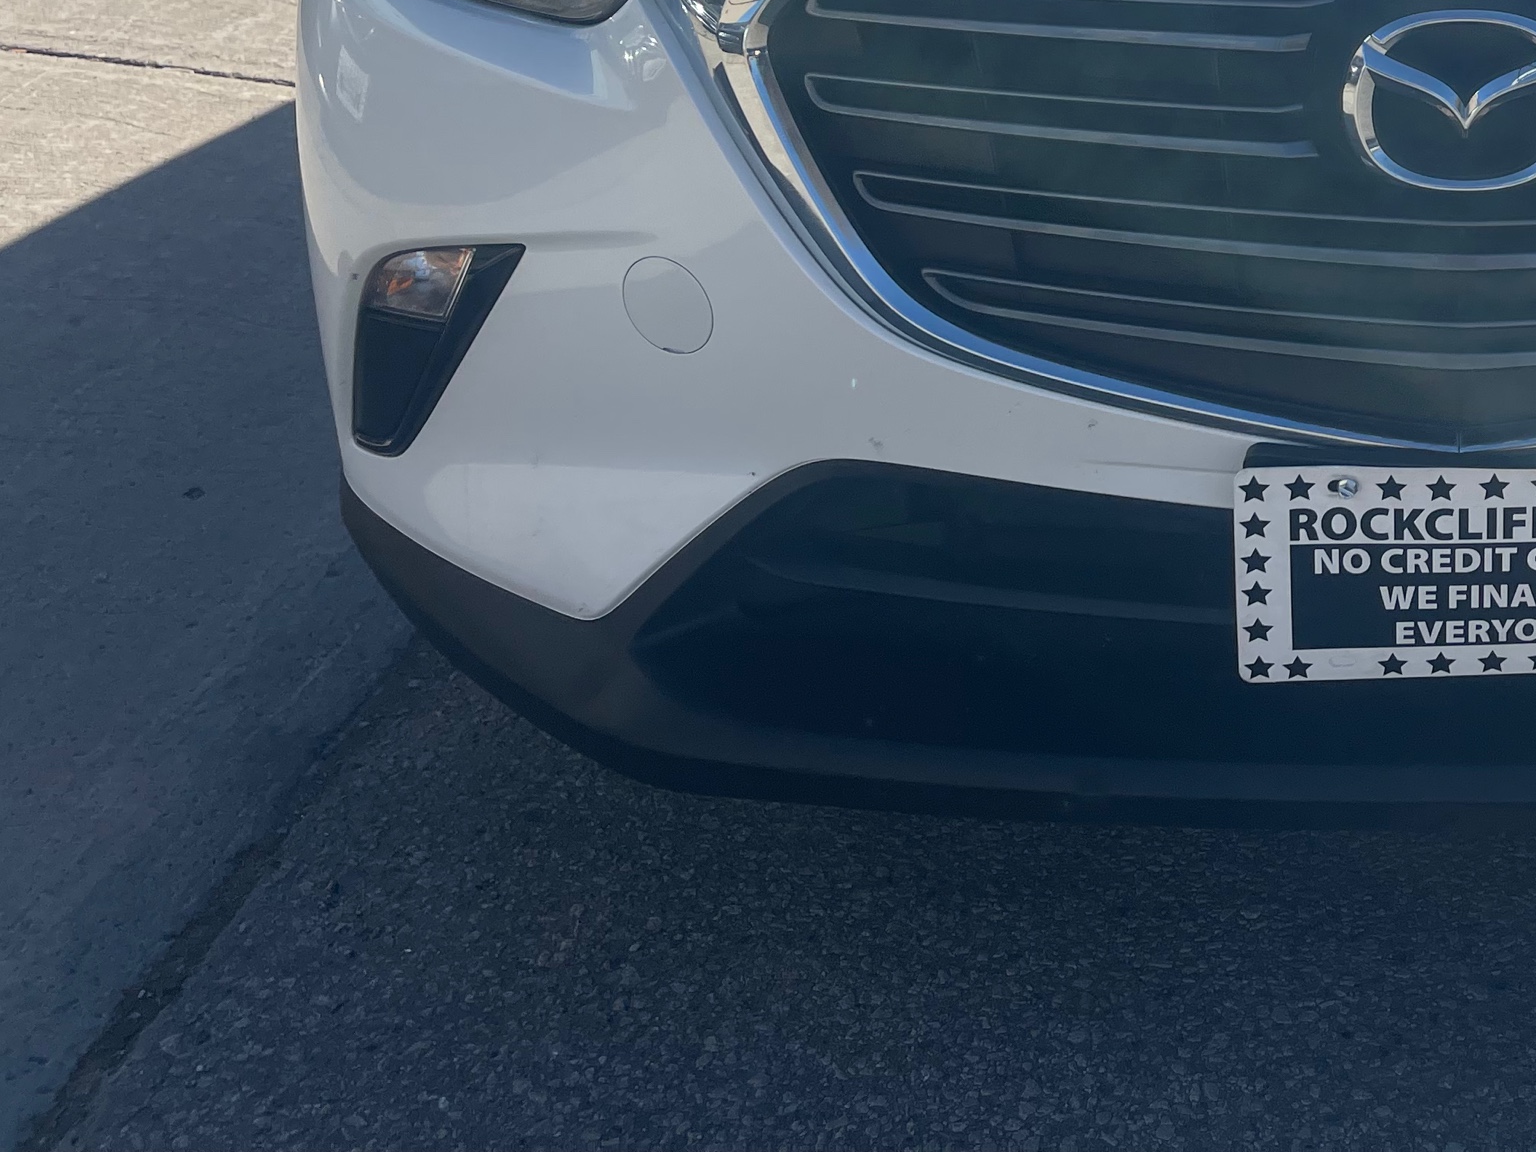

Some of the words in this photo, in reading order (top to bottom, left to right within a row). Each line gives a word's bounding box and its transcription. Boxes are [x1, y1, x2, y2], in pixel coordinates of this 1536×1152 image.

[1313, 547, 1371, 575] NO
[1380, 546, 1518, 574] CREDIT
[1379, 585, 1439, 611] WE
